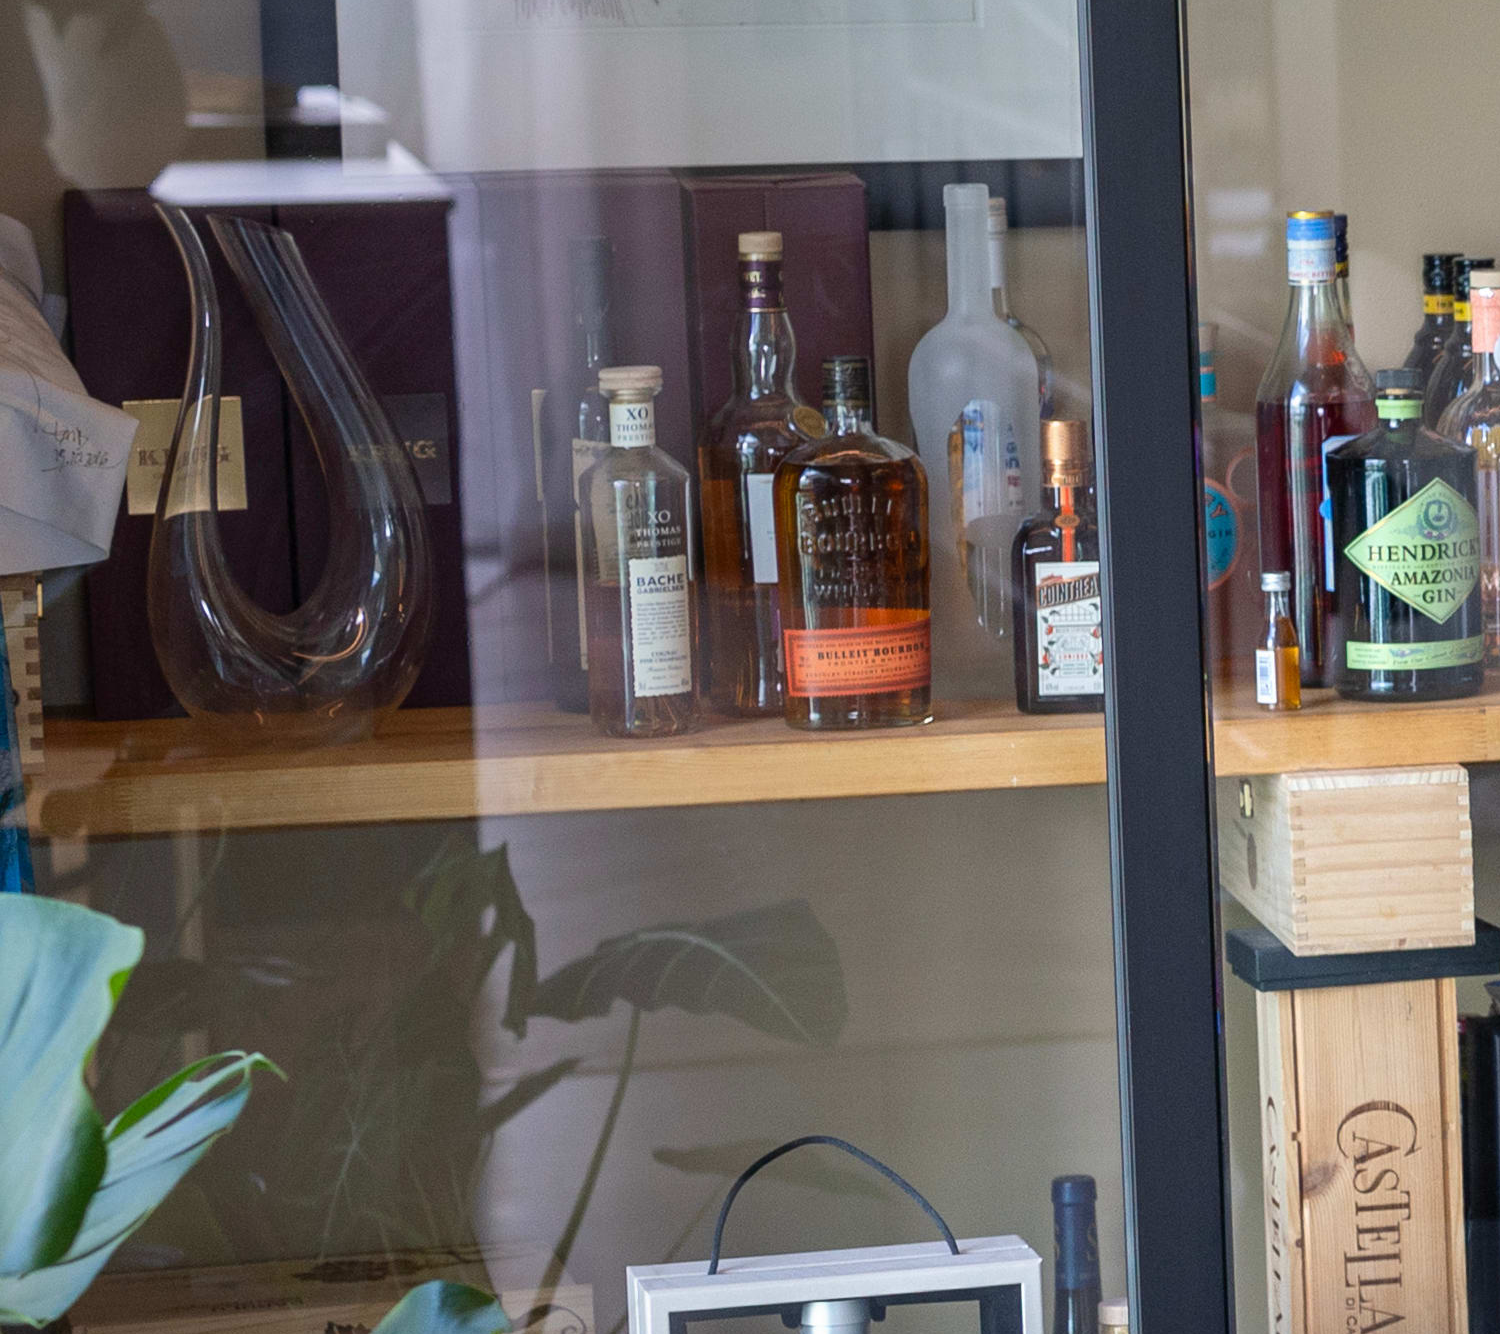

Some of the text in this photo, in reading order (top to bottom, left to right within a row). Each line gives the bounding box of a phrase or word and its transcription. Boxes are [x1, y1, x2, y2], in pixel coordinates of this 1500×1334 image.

[626, 406, 649, 421] XO
[647, 509, 671, 525] XO
[635, 525, 682, 538] THOMAS
[636, 573, 684, 587] BACHE
[1421, 587, 1457, 604] GIN
[817, 648, 868, 661] BULLEIT
[1345, 1297, 1355, 1315] DI
